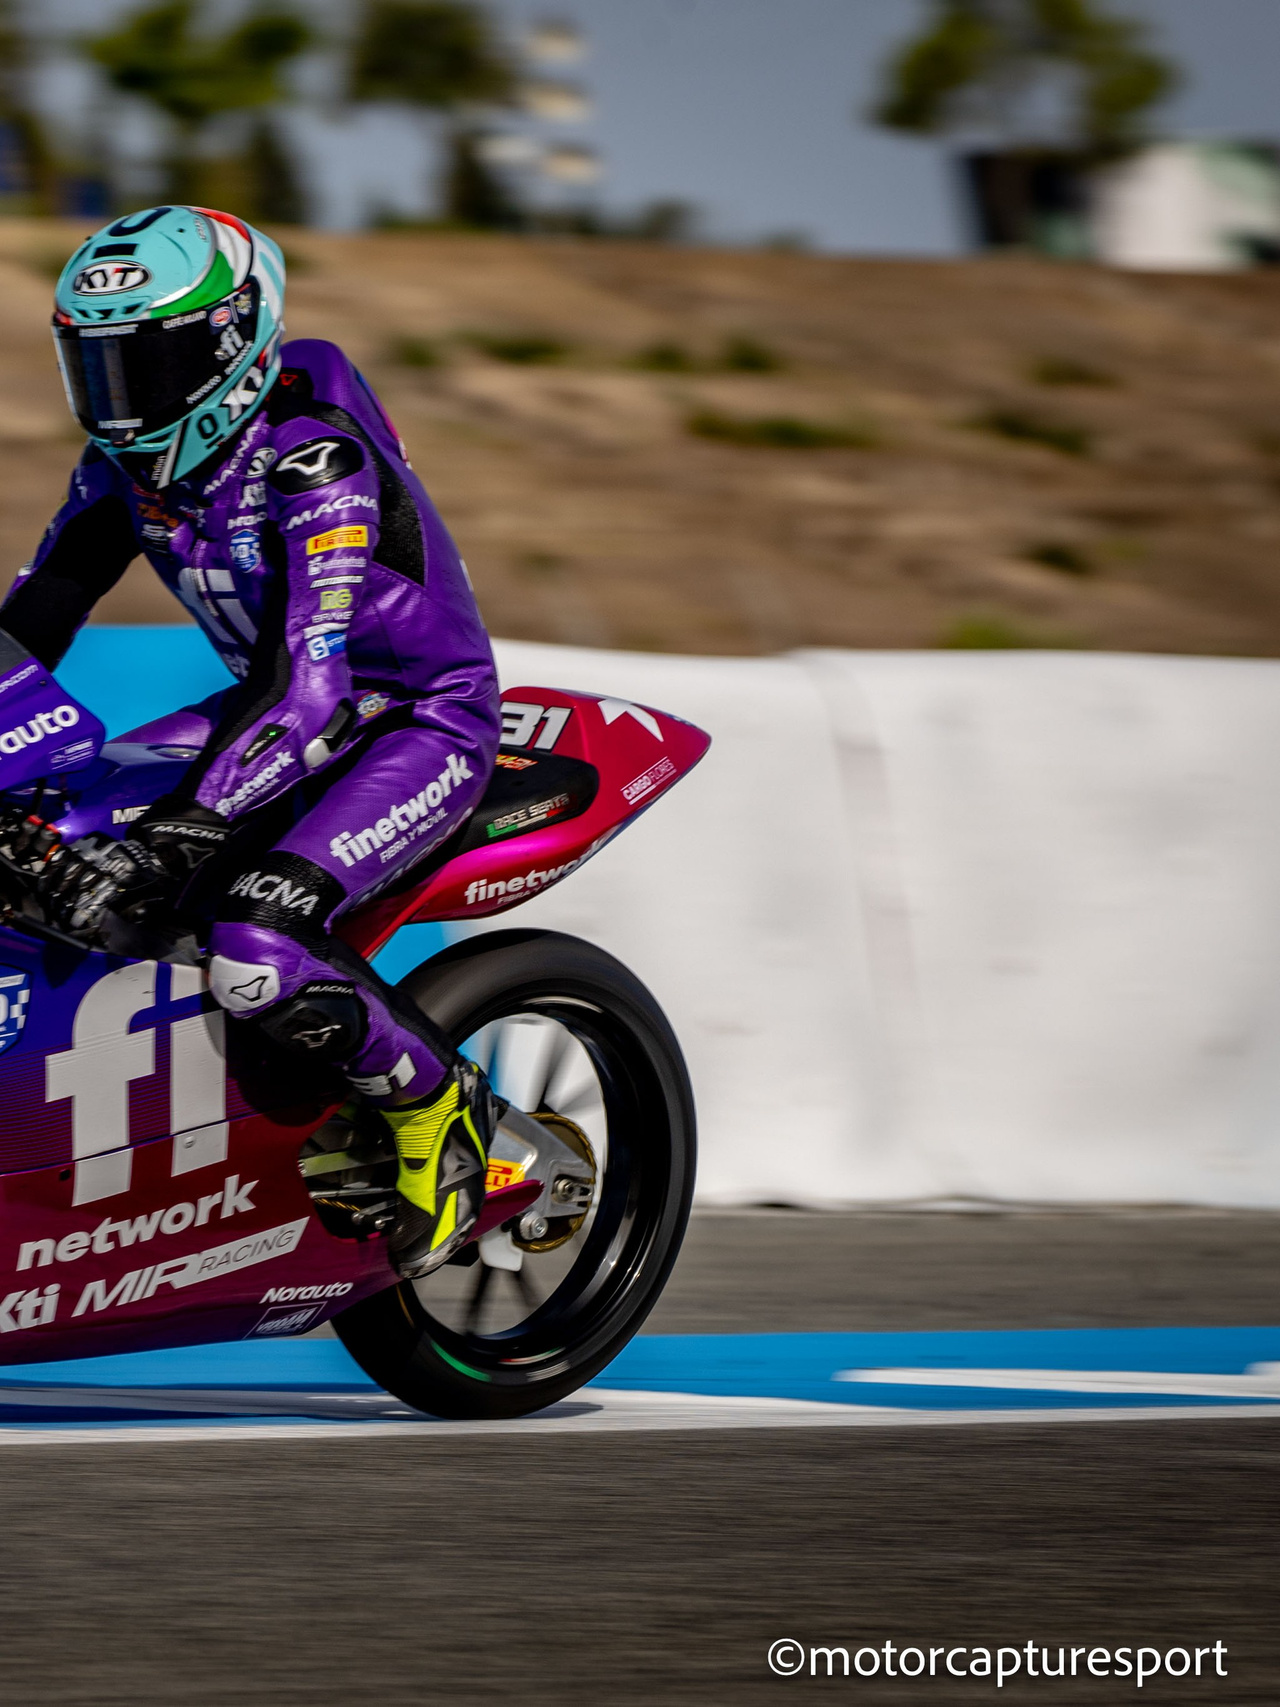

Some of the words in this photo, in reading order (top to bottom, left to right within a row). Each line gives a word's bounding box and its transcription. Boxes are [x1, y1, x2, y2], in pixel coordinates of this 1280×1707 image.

[286, 494, 379, 531] MACNA
[314, 529, 364, 549] PIRELLI
[499, 701, 572, 751] 31
[329, 753, 474, 868] finetwork
[494, 809, 528, 830] RACE
[528, 792, 570, 818] SEATS
[151, 825, 225, 842] MACNA
[306, 984, 354, 996] MACNA
[16, 1174, 259, 1272] network
[71, 1252, 204, 1318] MIR
[197, 1226, 296, 1275] RACING
[259, 1281, 354, 1305] Norauto
